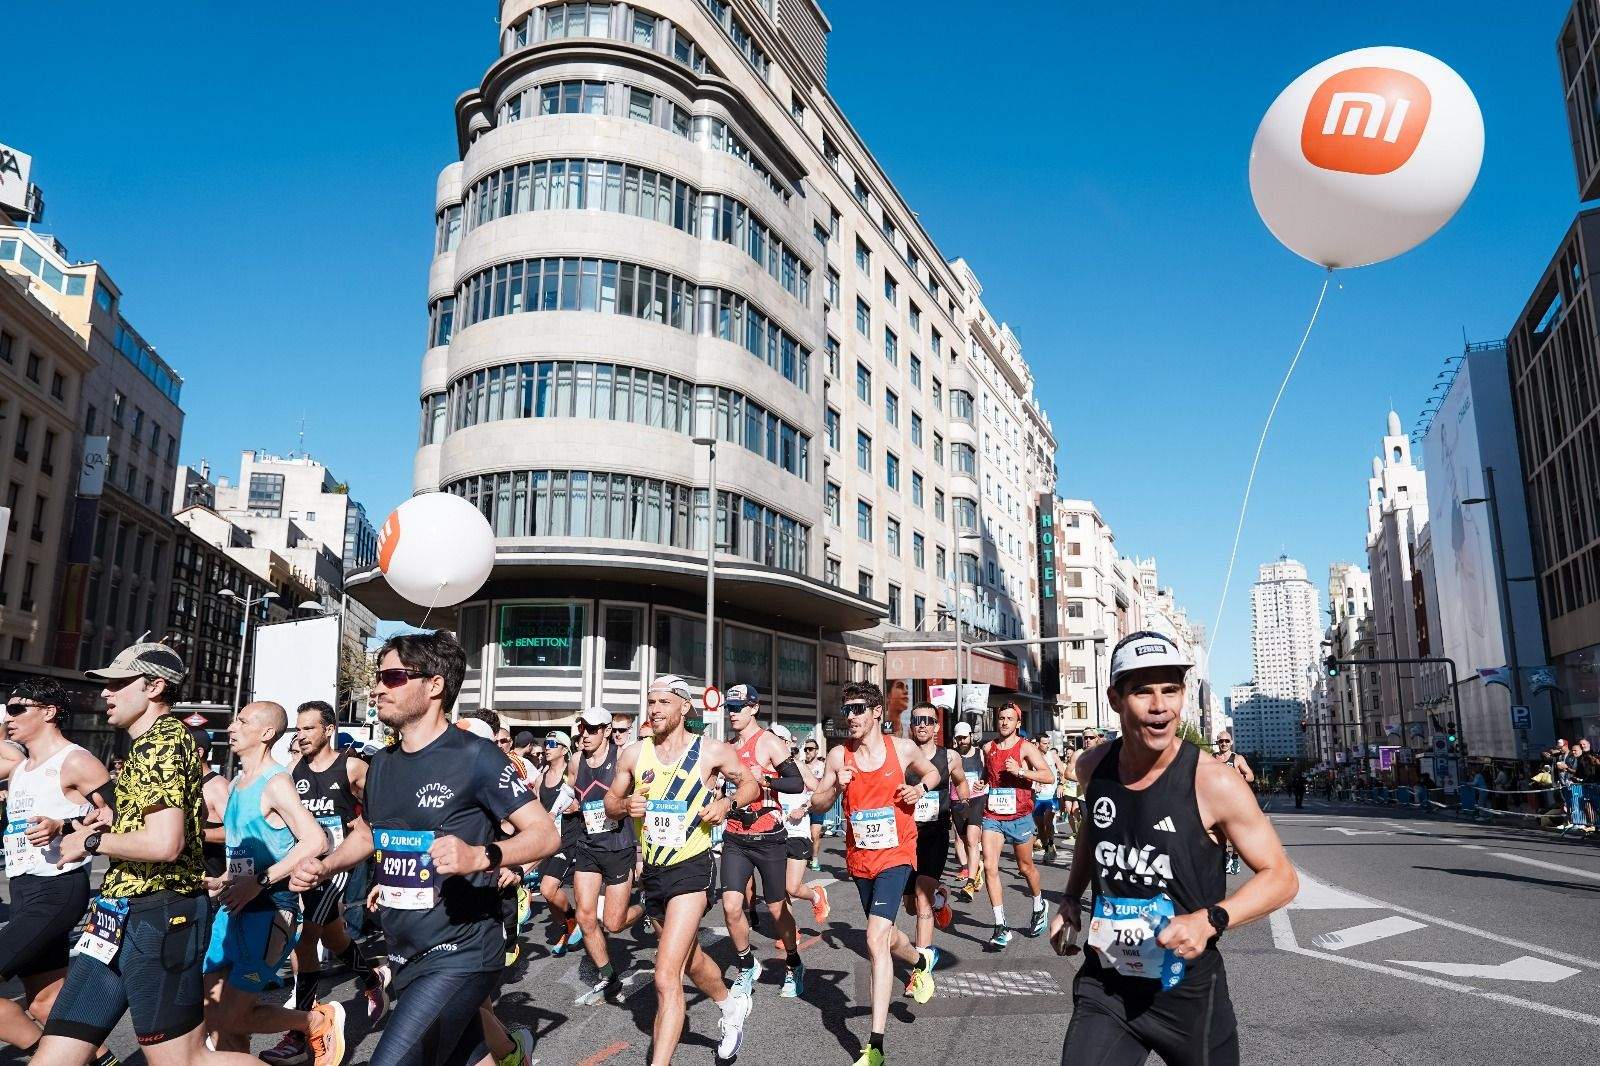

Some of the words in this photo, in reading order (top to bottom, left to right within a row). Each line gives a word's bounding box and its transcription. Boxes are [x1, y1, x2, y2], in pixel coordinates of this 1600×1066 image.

[1041, 514, 1054, 599] HOTEL
[1512, 706, 1529, 723] P
[415, 781, 455, 800] runners
[417, 795, 446, 808] AMS
[654, 816, 670, 828] 818
[866, 823, 881, 833] 537
[390, 836, 422, 846] ZURICH
[383, 857, 417, 877] 42912
[1095, 840, 1174, 879] GUÍA
[1115, 901, 1158, 915] ZURICH
[96, 910, 116, 933] 21120
[1113, 928, 1145, 947] 789
[1122, 949, 1140, 957] TIGRE
